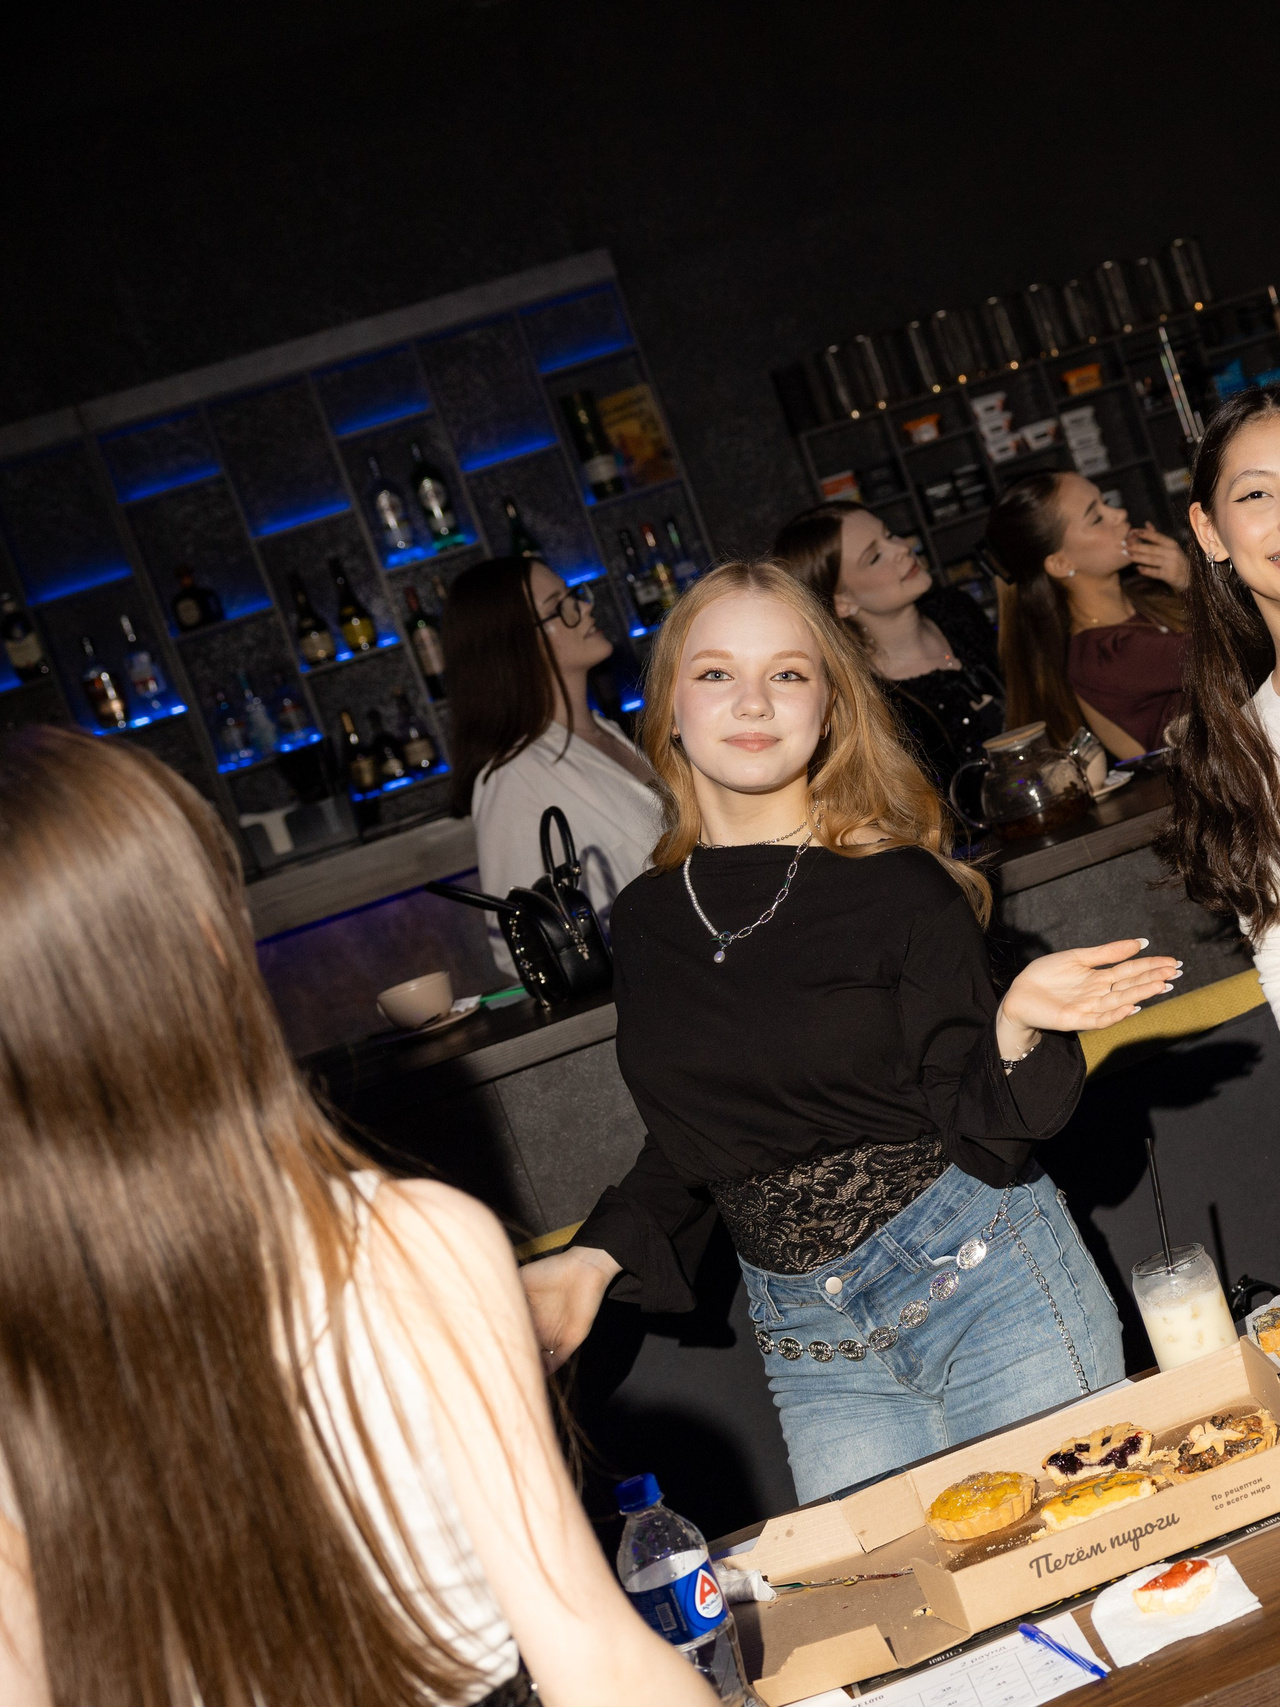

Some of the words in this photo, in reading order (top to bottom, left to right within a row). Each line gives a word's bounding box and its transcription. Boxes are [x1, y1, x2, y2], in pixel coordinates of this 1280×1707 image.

[1211, 1493, 1223, 1502] По
[1224, 1476, 1264, 1498] рецептам
[1214, 1502, 1225, 1511] со
[1226, 1494, 1249, 1507] всего
[1250, 1483, 1272, 1497] мира
[1029, 1542, 1107, 1579] Печём
[1109, 1513, 1181, 1552] пироги
